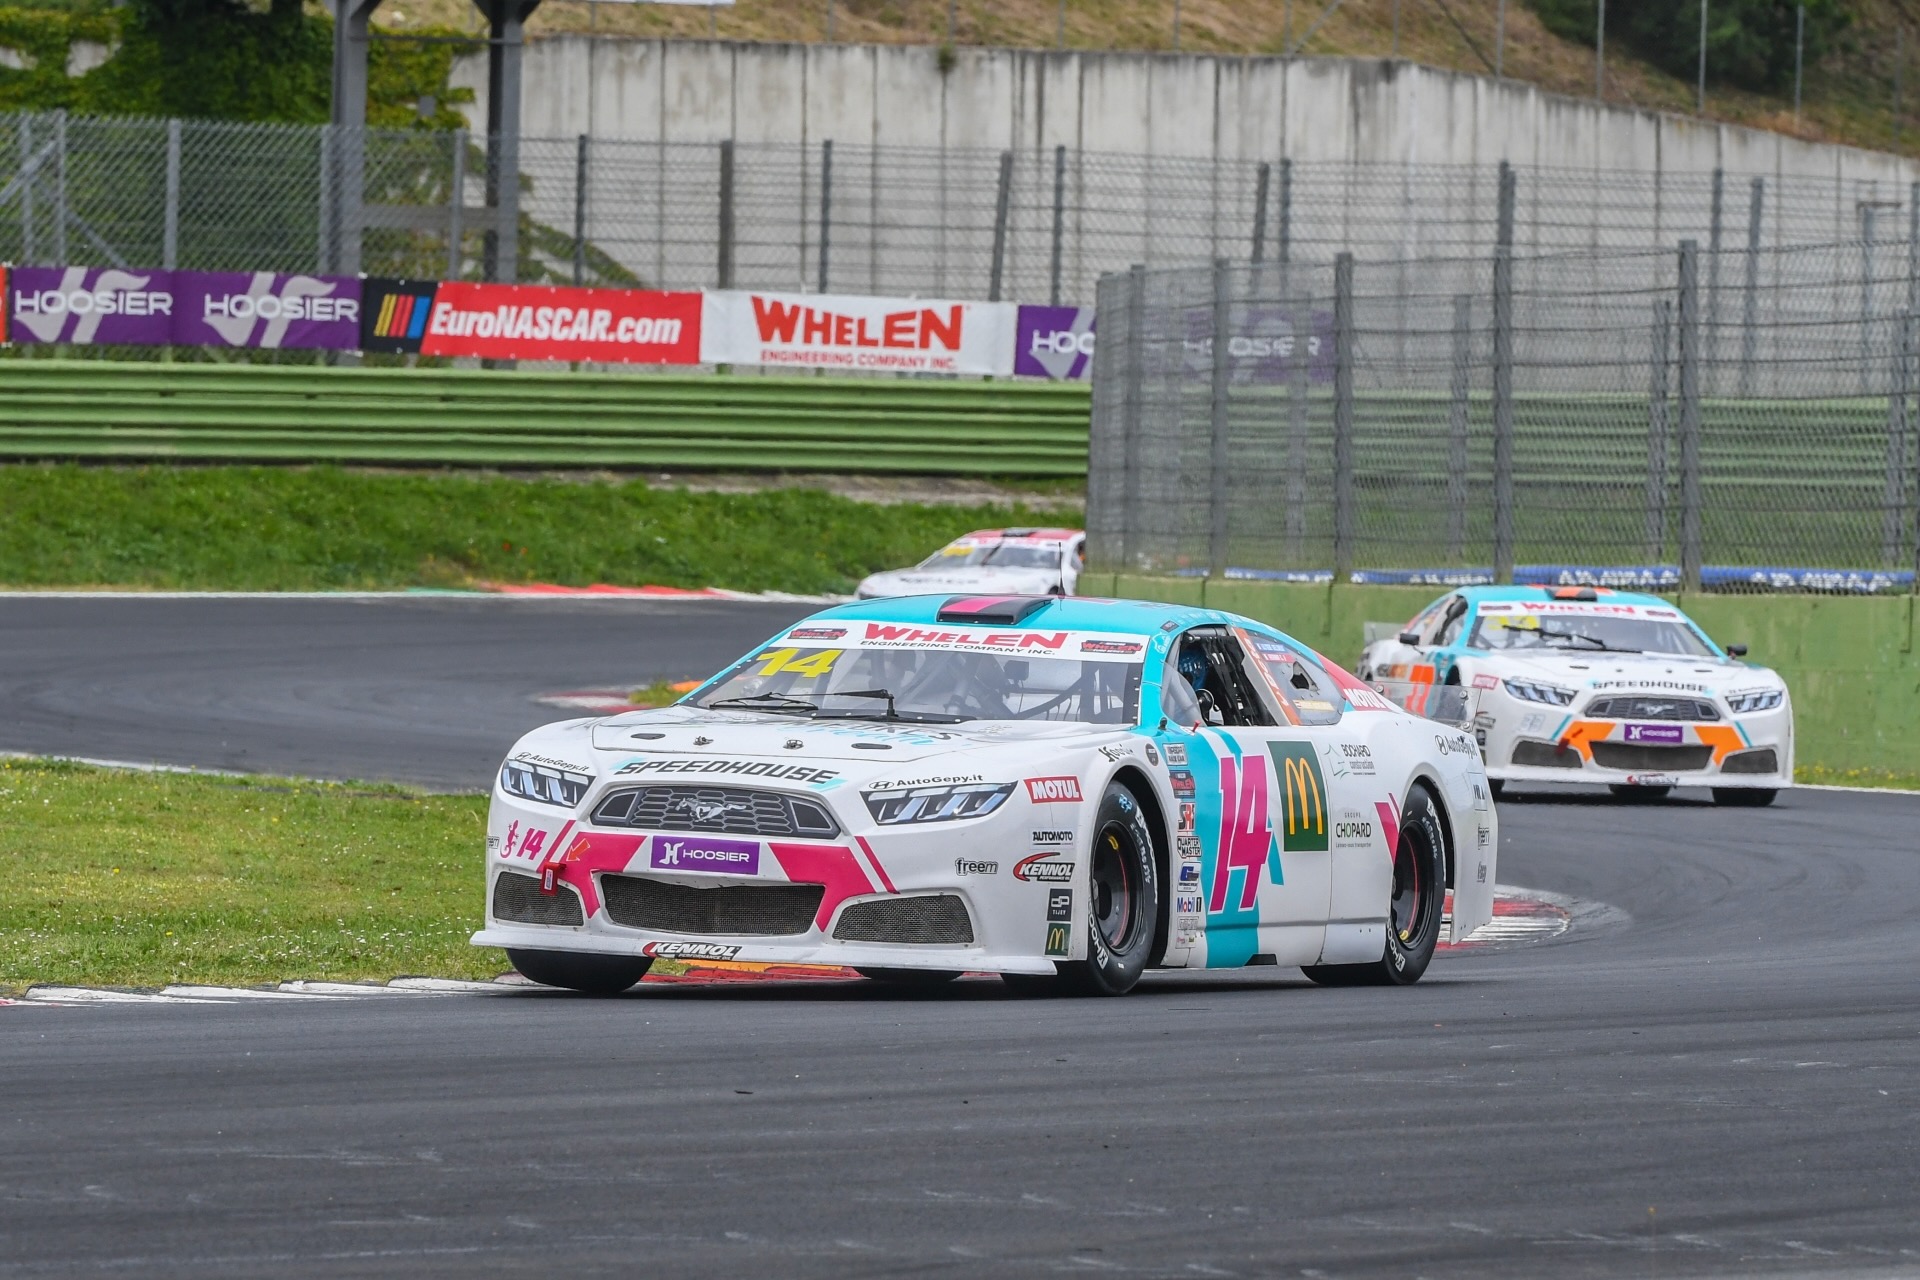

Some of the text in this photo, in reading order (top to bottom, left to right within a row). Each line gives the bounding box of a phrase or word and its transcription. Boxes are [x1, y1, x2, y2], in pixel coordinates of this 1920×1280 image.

[15, 290, 173, 316] HOOSIER
[205, 293, 359, 323] HOOSIER
[431, 303, 682, 345] EuroNASCAR.com
[751, 296, 963, 351] WHELEN
[761, 349, 957, 370] ENGINEERING COMPANY INC.
[1521, 602, 1635, 614] WHELEN
[864, 623, 1069, 650] WHELEN
[860, 640, 1056, 656] ENGINEERING COMPANY INC.
[756, 648, 844, 678] 14
[530, 752, 591, 773] AutoGepy.it
[614, 760, 840, 785] SPEEDHOUSE
[896, 774, 984, 787] AutoGepy.it
[1031, 779, 1080, 799] MOTUL
[1032, 831, 1074, 842] AUTOMOTO
[1208, 755, 1273, 915] 14
[1335, 822, 1372, 838] CHOPARD
[519, 828, 548, 861] 14
[1177, 837, 1200, 850] QUARTER
[1181, 846, 1201, 856] MASTER
[682, 849, 750, 864] HOOSIER
[957, 858, 998, 876] freem
[1021, 863, 1073, 877] KENNOL
[1177, 897, 1202, 912] Mobil 1
[649, 943, 736, 957] KENNOL
